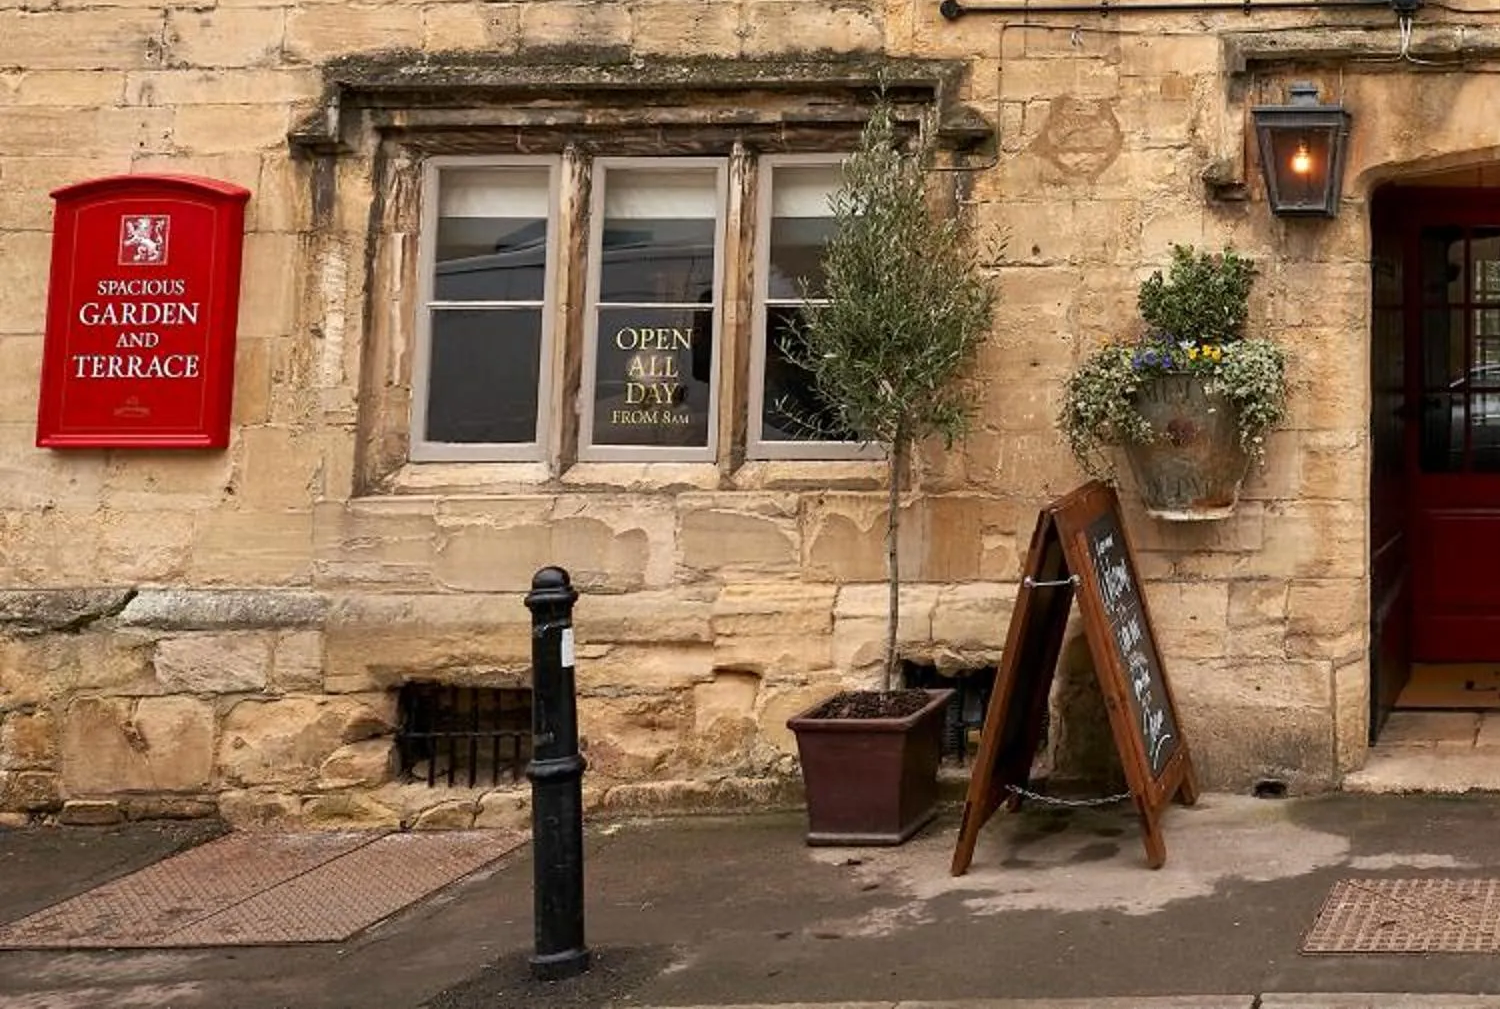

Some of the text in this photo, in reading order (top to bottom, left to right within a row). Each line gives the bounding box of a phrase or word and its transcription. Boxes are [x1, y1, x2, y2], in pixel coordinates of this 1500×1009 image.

[97, 279, 185, 295] SPACIOUS
[79, 302, 200, 326] GARDEN
[116, 333, 159, 348] AND
[616, 327, 693, 350] OPEN
[72, 354, 200, 379] TERRACE
[629, 355, 679, 378] ALL
[625, 382, 679, 404] DAY
[611, 410, 658, 424] FROM
